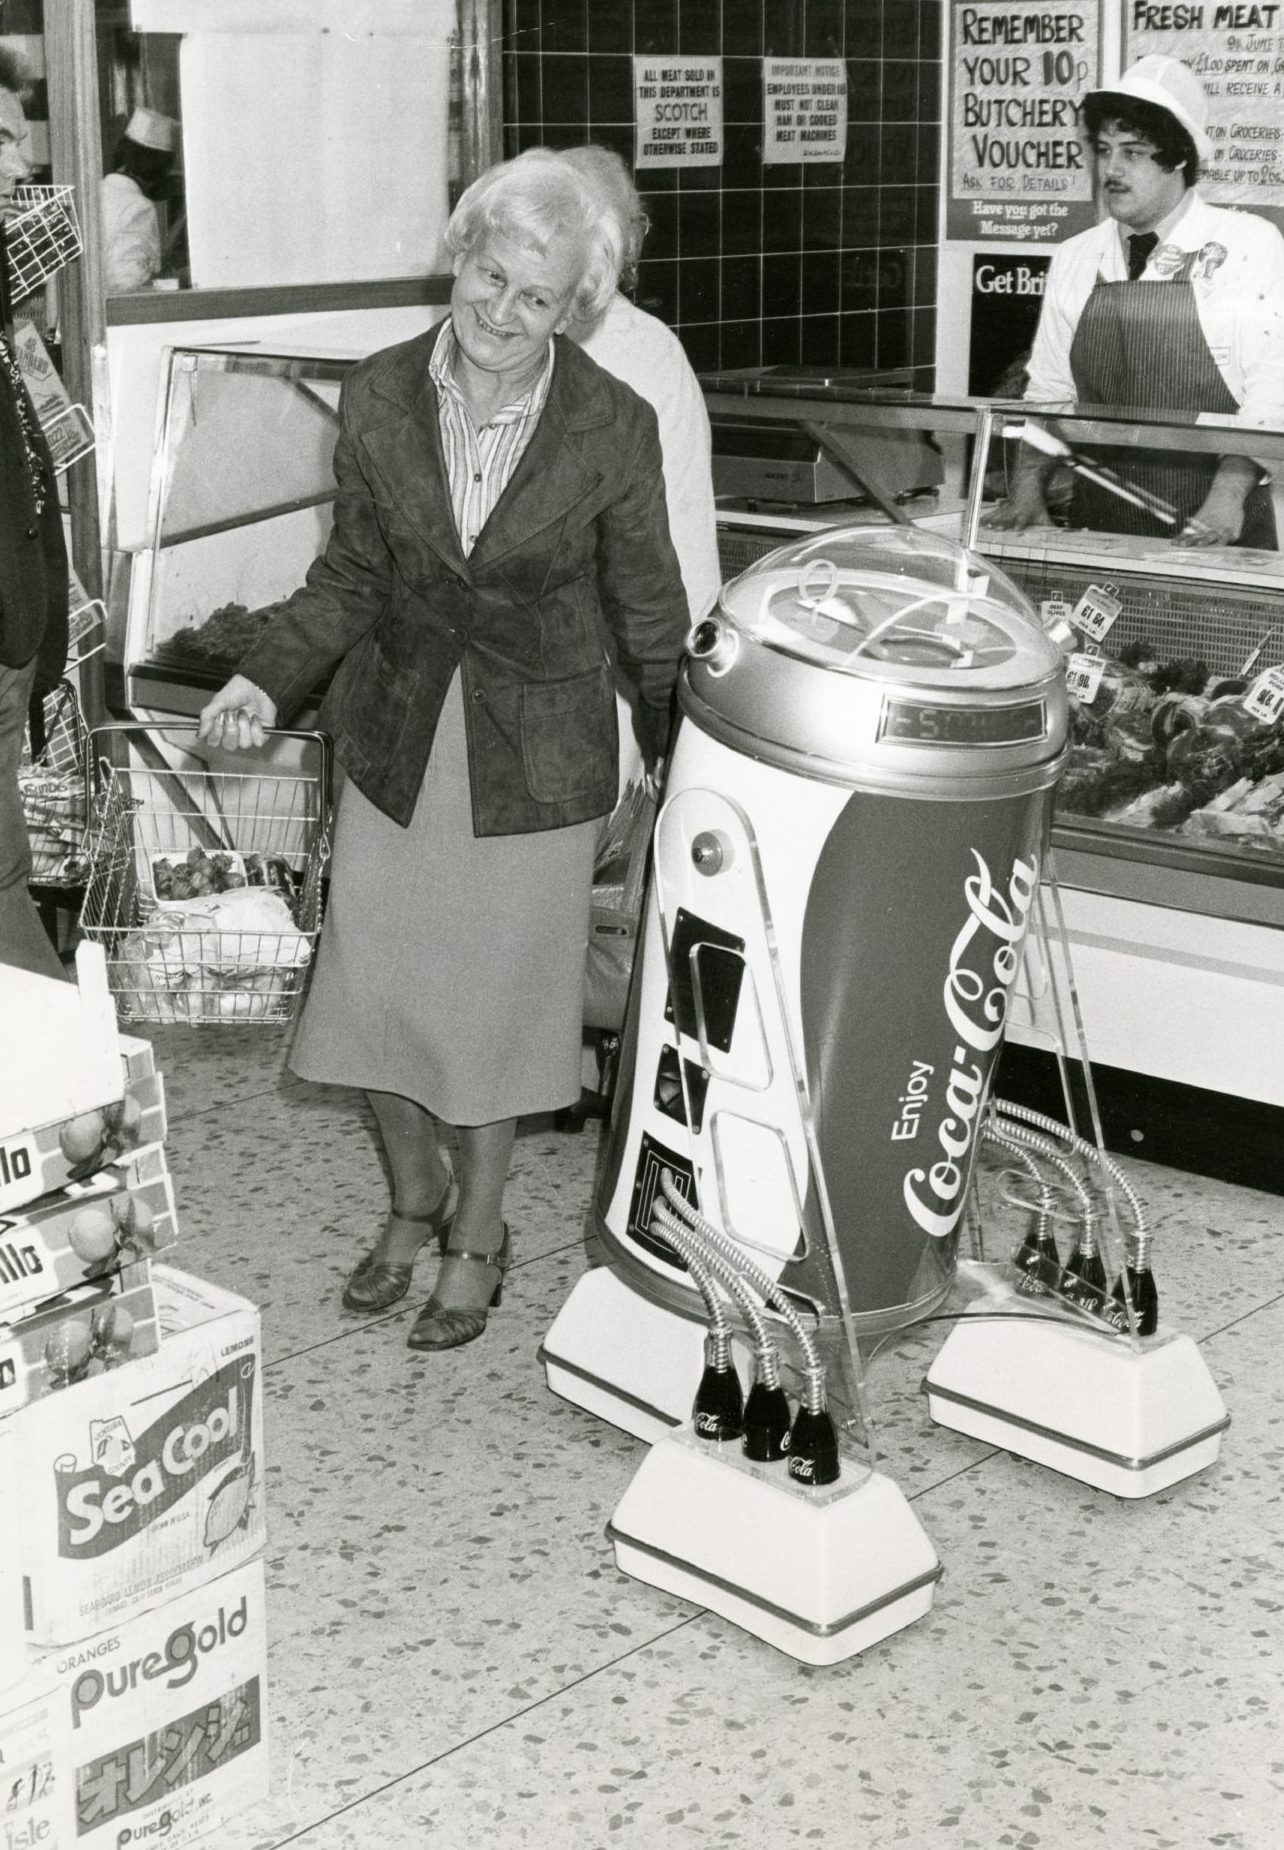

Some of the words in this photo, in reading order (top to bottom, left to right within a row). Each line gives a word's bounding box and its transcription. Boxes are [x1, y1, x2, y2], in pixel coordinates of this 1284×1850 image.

[1134, 0, 1204, 30] FRESH
[1213, 5, 1280, 28] MEAT
[962, 9, 1084, 44] REMEMBER
[1245, 34, 1274, 51] JUNE
[963, 57, 1030, 86] YOUR
[1225, 59, 1255, 72] SPENT
[1257, 60, 1270, 72] ON
[644, 70, 658, 82] ALL
[662, 69, 682, 82] MEAT
[684, 69, 704, 82] SOLD
[707, 70, 716, 81] IN
[640, 86, 656, 98] THIS
[660, 86, 710, 98] DEPARTMENT
[712, 86, 720, 98] IS
[767, 83, 810, 95] EMPLOYEES
[812, 83, 836, 95] UNDER
[1226, 82, 1268, 95] RECEIVE
[1274, 82, 1280, 95] A
[656, 102, 708, 122] SCOTCH
[775, 99, 794, 111] MUST
[800, 99, 812, 111] NOT
[816, 100, 839, 111] CLEAN
[964, 93, 1084, 127] BUTCHERY
[776, 114, 792, 126] HAM
[796, 114, 806, 126] OR
[810, 114, 838, 126] COOKED
[652, 128, 681, 140] EXCEPT
[686, 126, 712, 139] WHERE
[776, 130, 796, 142] MEAT
[800, 130, 837, 142] MACHINES
[1230, 124, 1281, 140] GROCERIES
[643, 142, 686, 156] OTHERWISE
[690, 142, 718, 154] STATED
[971, 133, 1084, 168] VOUCHER
[1229, 145, 1278, 161] GROCERIES
[963, 174, 983, 189] ASK
[991, 176, 1014, 190] FOR
[1234, 170, 1246, 182] UP
[1248, 171, 1259, 182] TO
[972, 201, 1003, 215] Have
[1005, 204, 1027, 219] you
[1030, 204, 1048, 218] got
[1050, 202, 1068, 217] the
[980, 221, 1030, 238] Message
[1031, 223, 1058, 238] yet?
[976, 264, 1014, 294] Get
[1017, 265, 1047, 296] Bri
[904, 848, 1038, 1237] Coca-Cola
[891, 1060, 934, 1140] Enjoy
[220, 1336, 255, 1357] LEMONS
[66, 1459, 165, 1546] Sea
[162, 1385, 238, 1476] Cool
[57, 1636, 121, 1674] ORANGES
